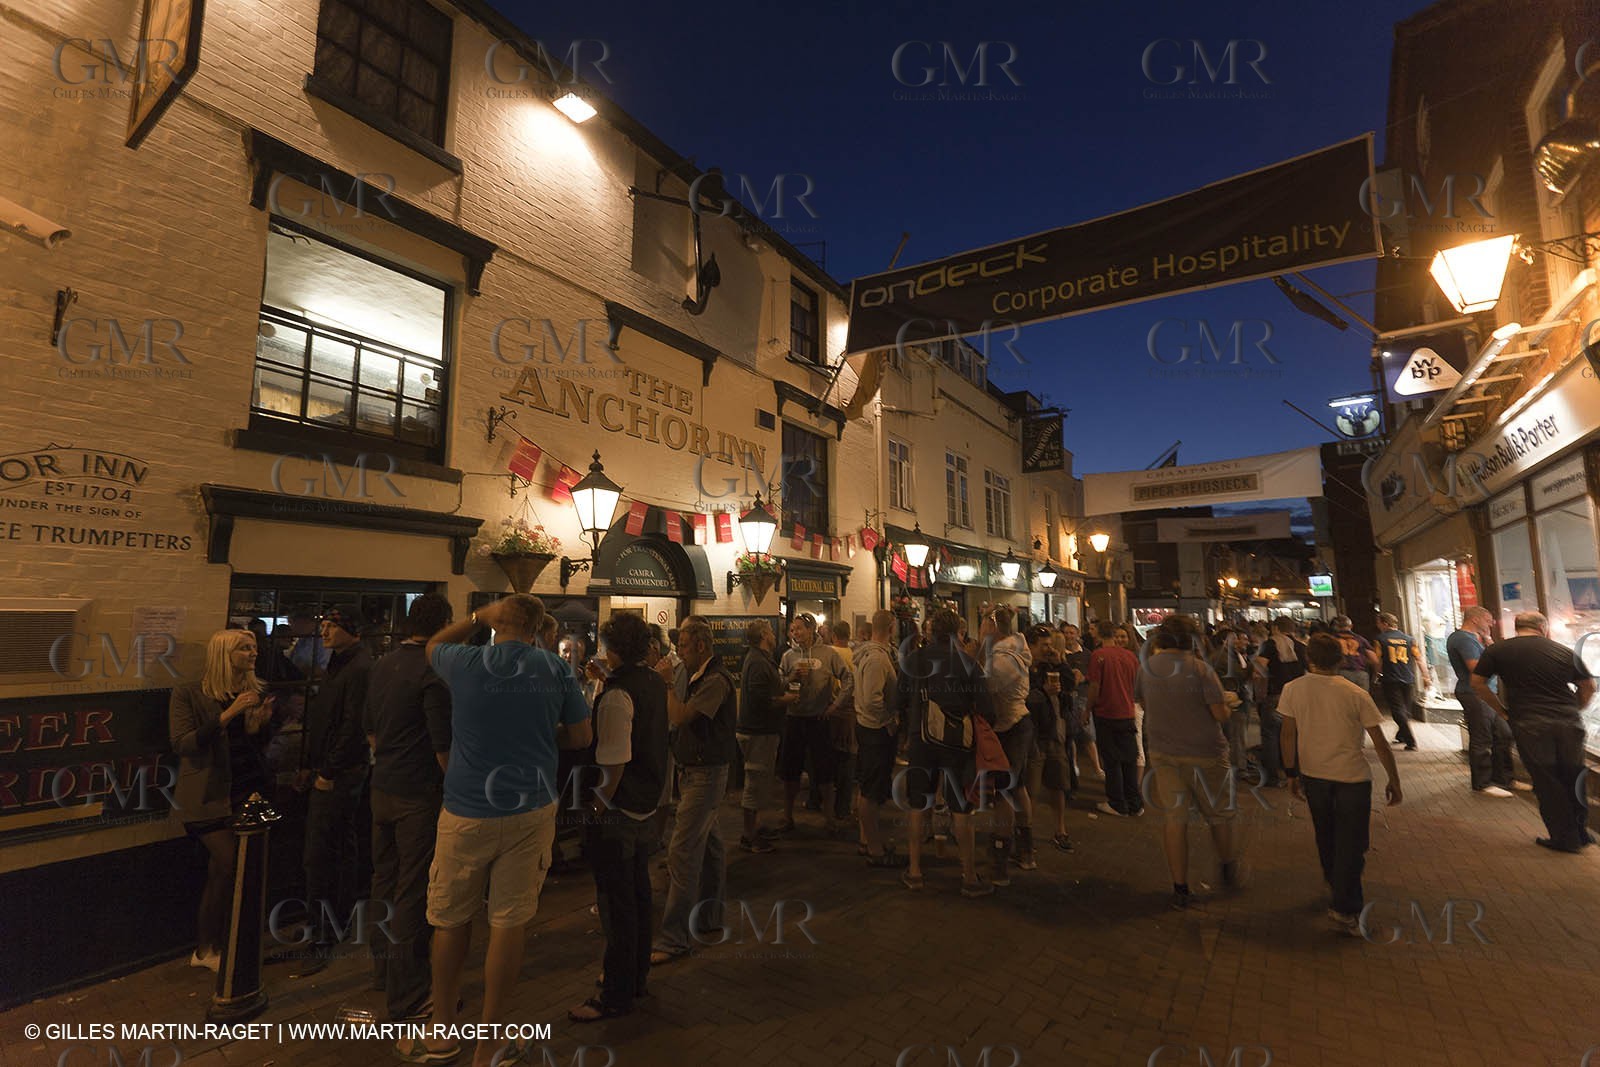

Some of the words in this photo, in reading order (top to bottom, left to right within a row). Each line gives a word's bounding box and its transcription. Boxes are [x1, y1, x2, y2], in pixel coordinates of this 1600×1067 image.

[992, 264, 1139, 314] Corporate
[1153, 221, 1350, 281] Hospitality
[624, 367, 693, 415] THE
[500, 365, 711, 458] ANCHOR
[717, 430, 767, 473] INN
[82, 454, 148, 484] INN
[83, 485, 132, 502] 1704
[0, 499, 49, 511] NDER
[55, 503, 82, 513] THE
[89, 506, 119, 517] SIGN
[124, 510, 142, 519] OF
[31, 524, 192, 551] TRUMPETERS
[615, 577, 669, 587] RECOMMENDED
[628, 568, 655, 578] CAMRA
[727, 620, 749, 630] ANCH
